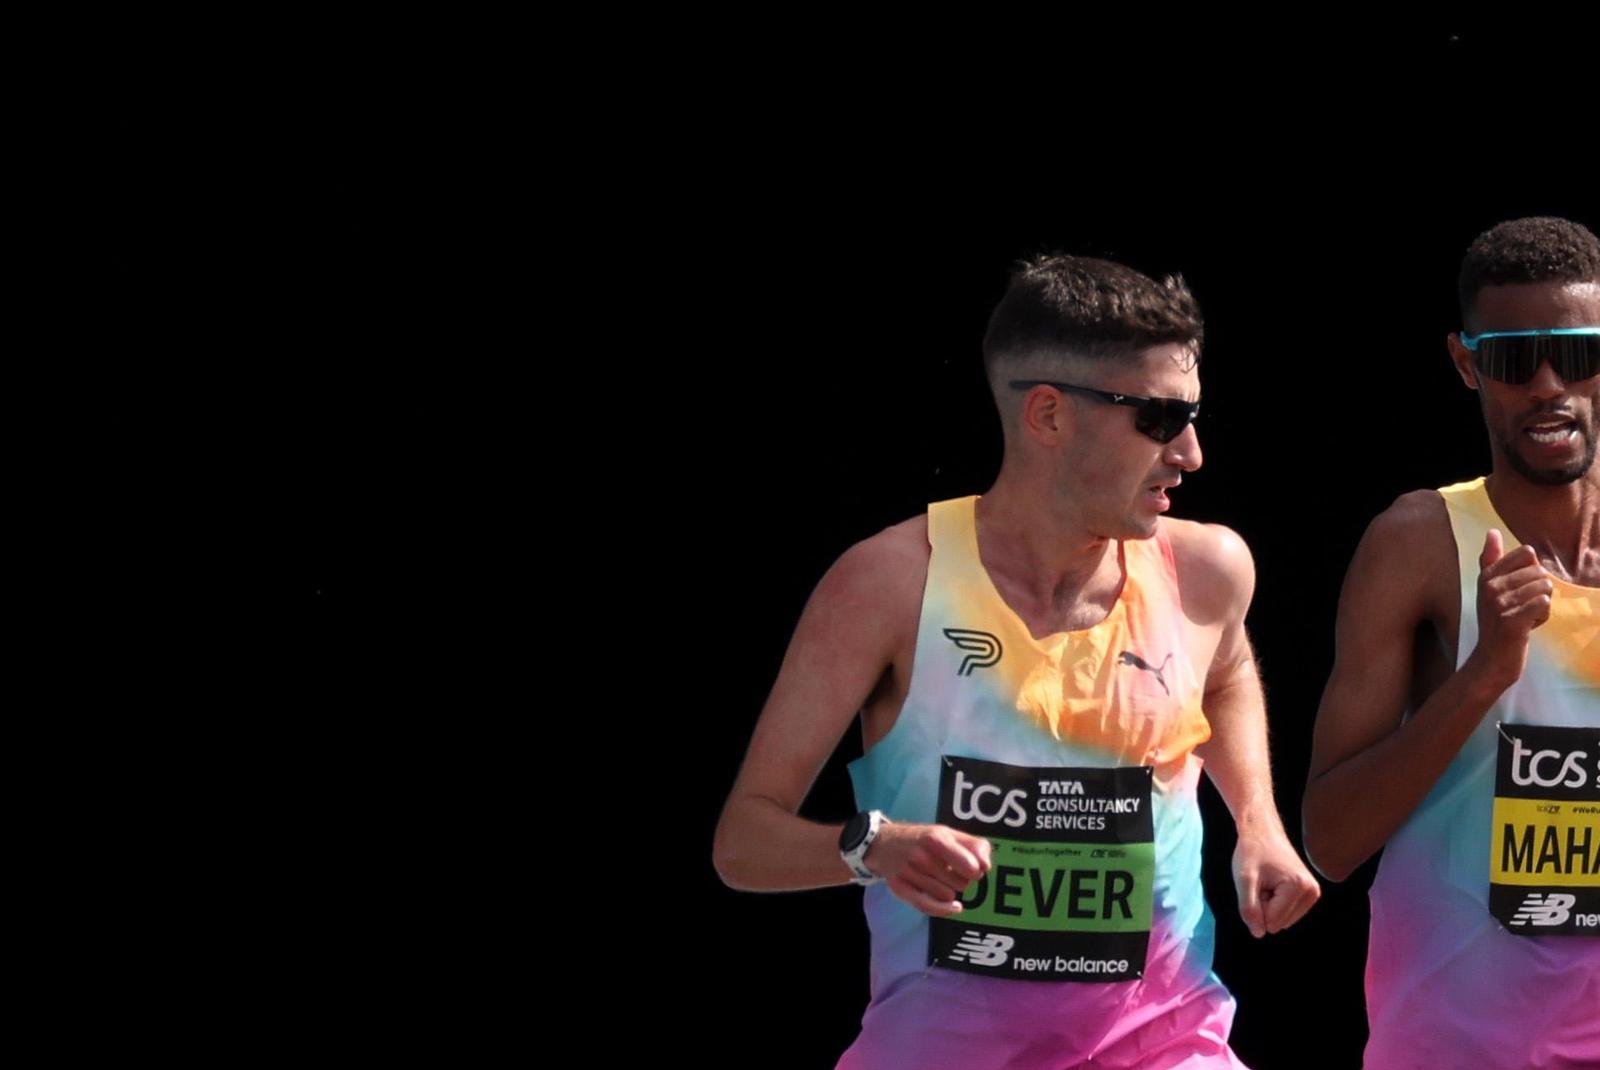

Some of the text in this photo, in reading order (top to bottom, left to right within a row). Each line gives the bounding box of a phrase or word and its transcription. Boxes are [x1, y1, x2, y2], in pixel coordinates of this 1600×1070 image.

[1511, 738, 1588, 788] tcs
[1038, 781, 1084, 795] TATA
[952, 770, 1028, 827] tcs
[1037, 798, 1140, 814] CONSULTANCY
[1035, 815, 1106, 830] SERVICES
[1013, 957, 1052, 971] new
[1055, 956, 1129, 974] balance
